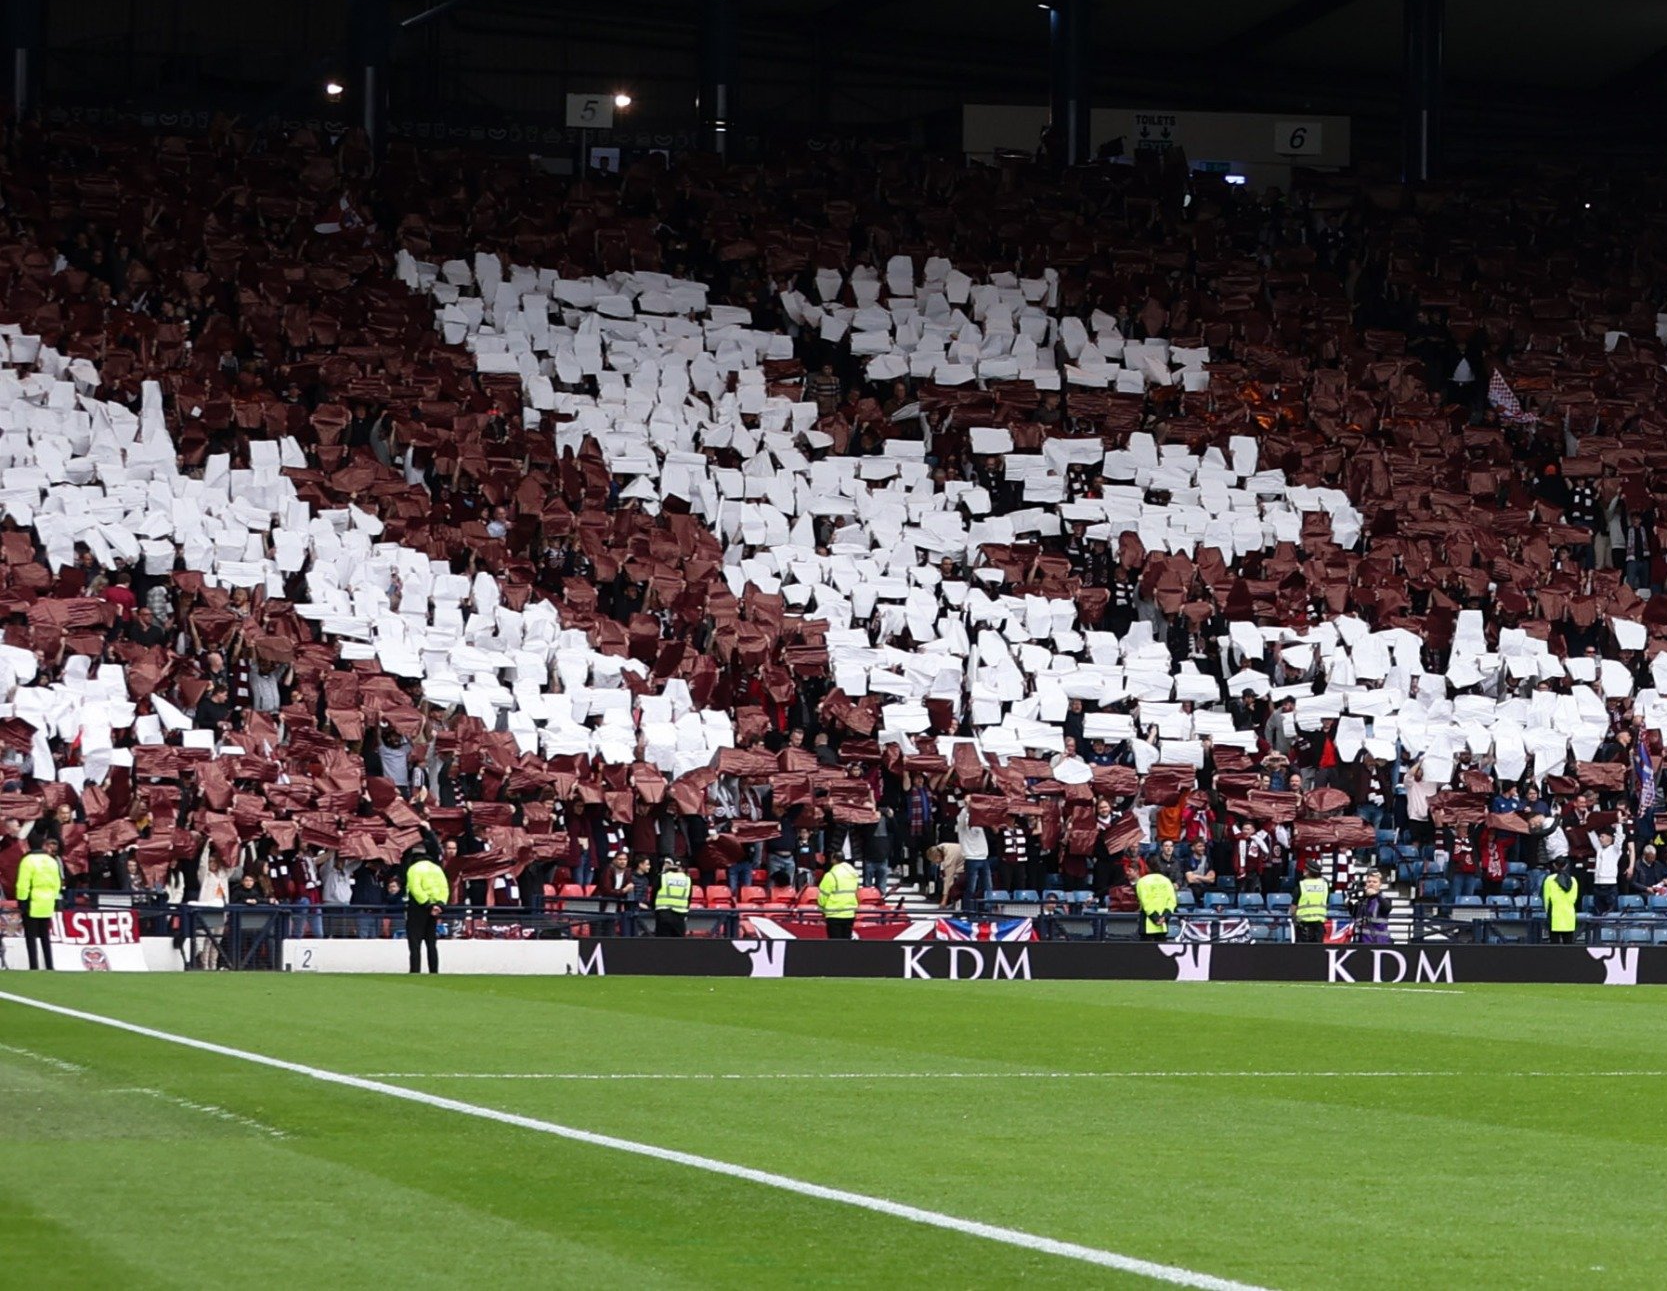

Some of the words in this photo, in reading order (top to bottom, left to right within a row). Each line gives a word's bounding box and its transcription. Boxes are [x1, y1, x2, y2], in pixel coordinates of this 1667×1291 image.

[580, 100, 599, 122] 5
[1135, 114, 1176, 126] TOILETS
[1289, 127, 1307, 149] 6
[302, 950, 312, 968] 2
[901, 945, 1033, 980] KDM
[1325, 948, 1454, 983] KDM
